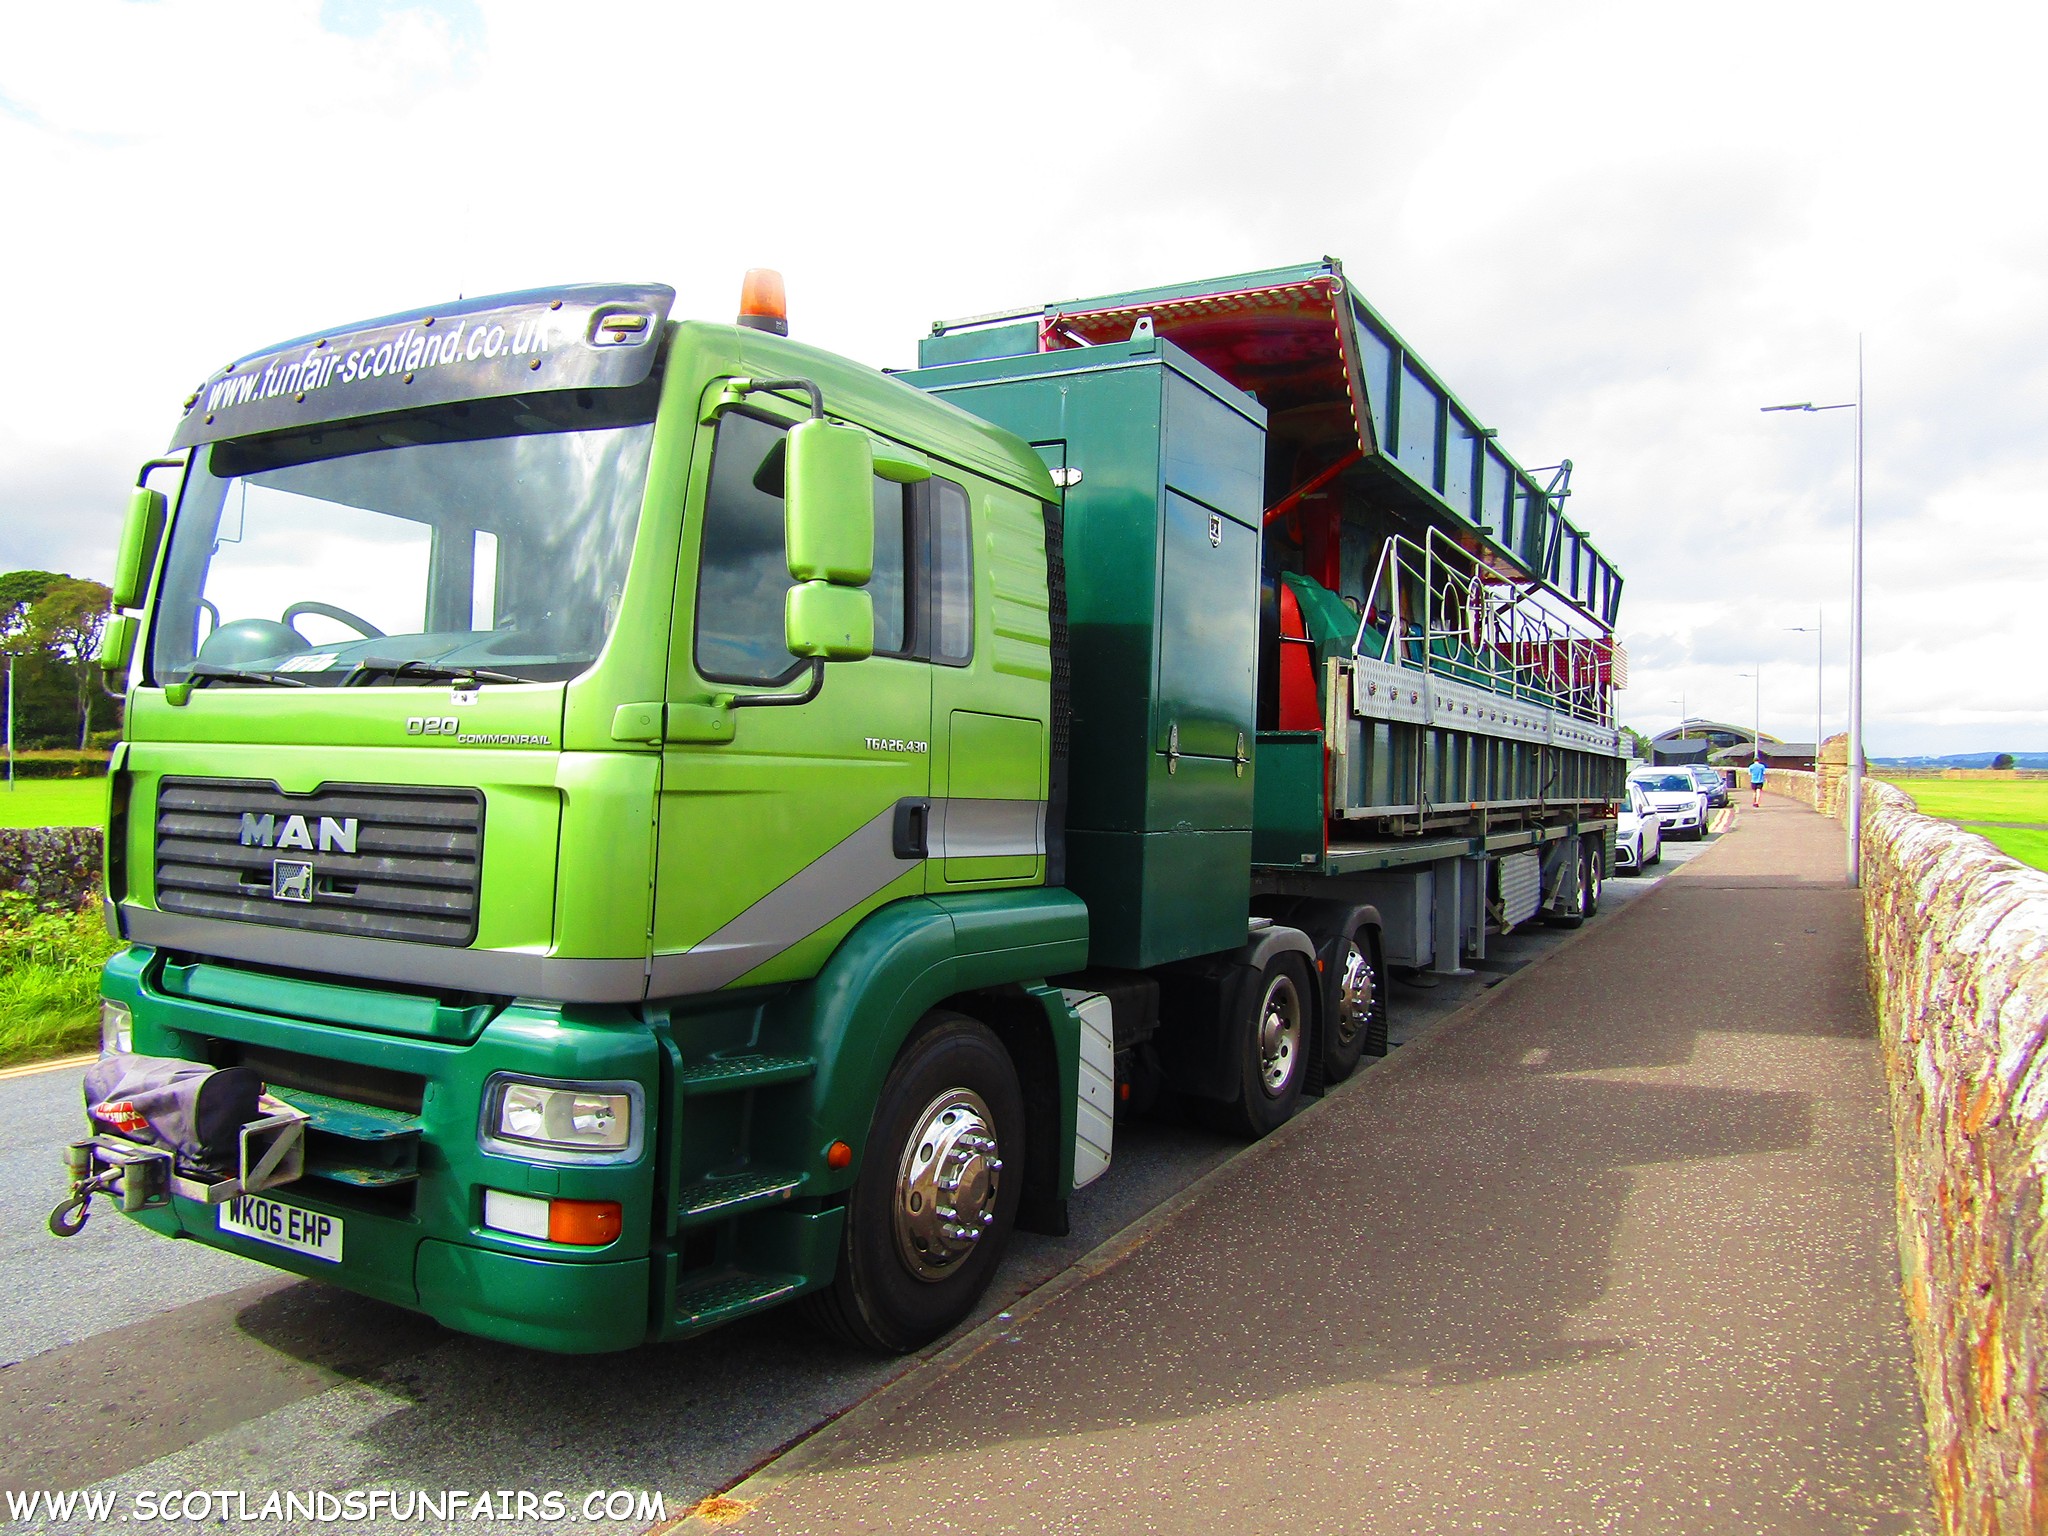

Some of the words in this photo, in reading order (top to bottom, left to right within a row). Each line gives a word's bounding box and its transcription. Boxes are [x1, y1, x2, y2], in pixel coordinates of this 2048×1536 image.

[206, 308, 551, 412] www.funfair-scotland.co.uk
[407, 716, 459, 735] D20
[457, 734, 551, 745] COMMONRAIL
[864, 737, 928, 753] TGA26.430
[241, 812, 358, 853] MAN
[230, 1195, 282, 1235] WK06
[288, 1208, 331, 1247] EHP
